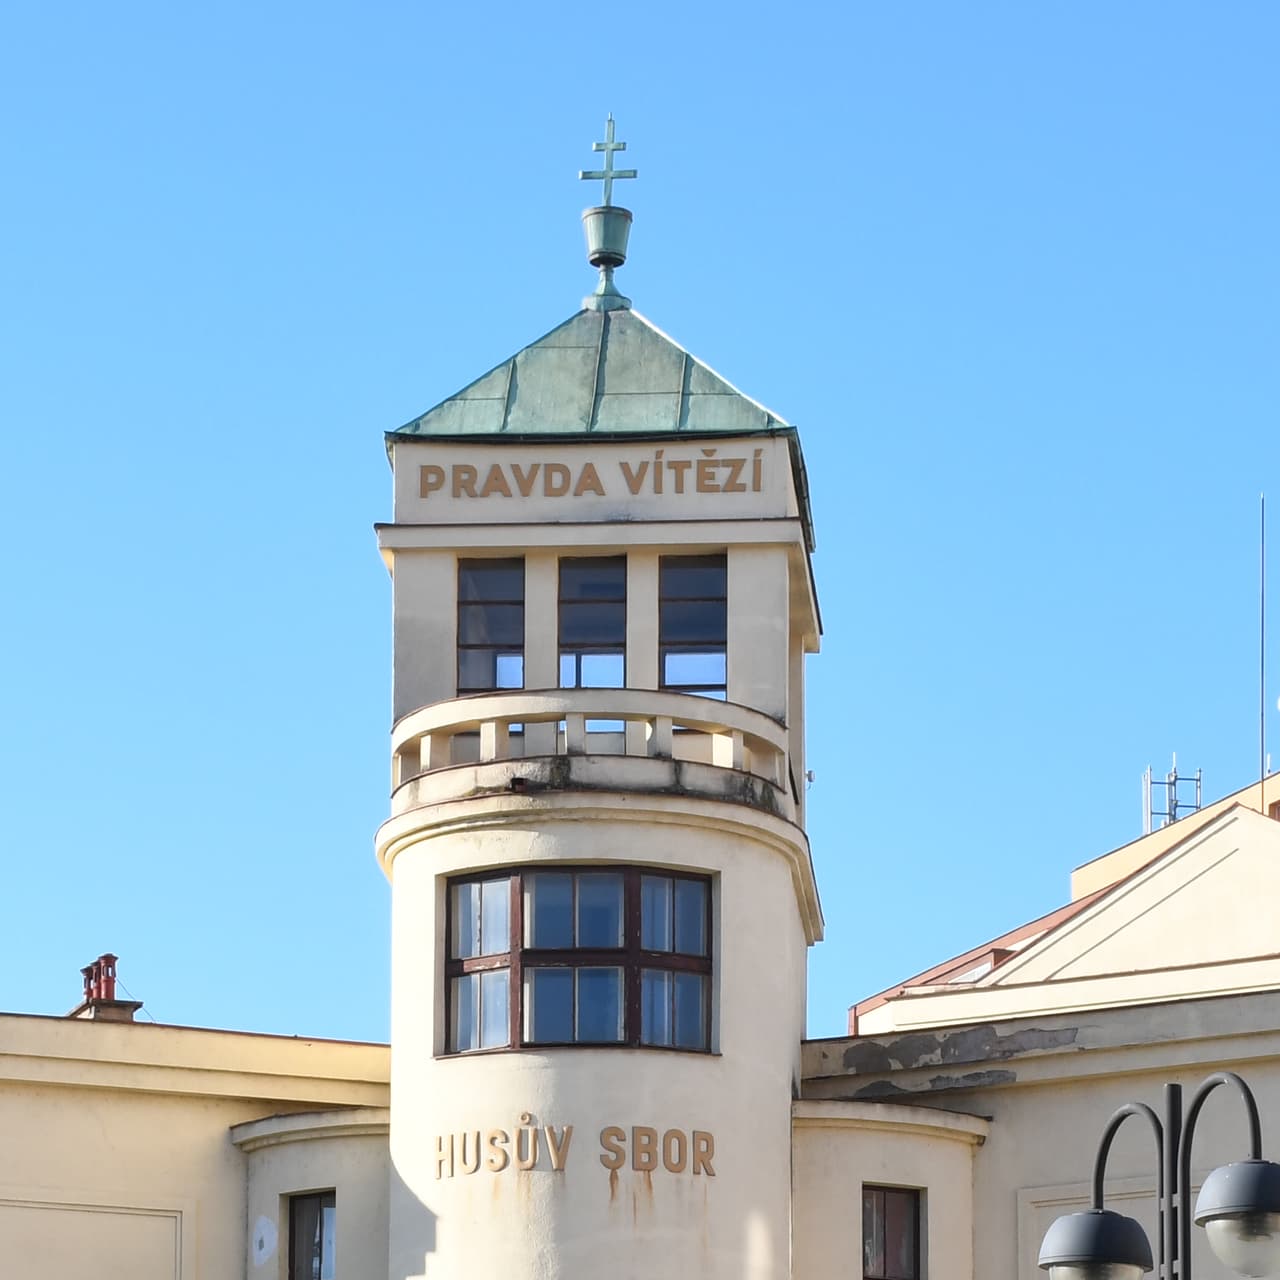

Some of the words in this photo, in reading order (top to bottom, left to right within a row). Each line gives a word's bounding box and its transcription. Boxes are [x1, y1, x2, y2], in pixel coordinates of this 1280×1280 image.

[419, 462, 606, 498] PRAVDA
[619, 448, 763, 494] VÍTĚZÍ
[434, 1111, 574, 1180] HUSŮV
[599, 1126, 717, 1177] SBOR
